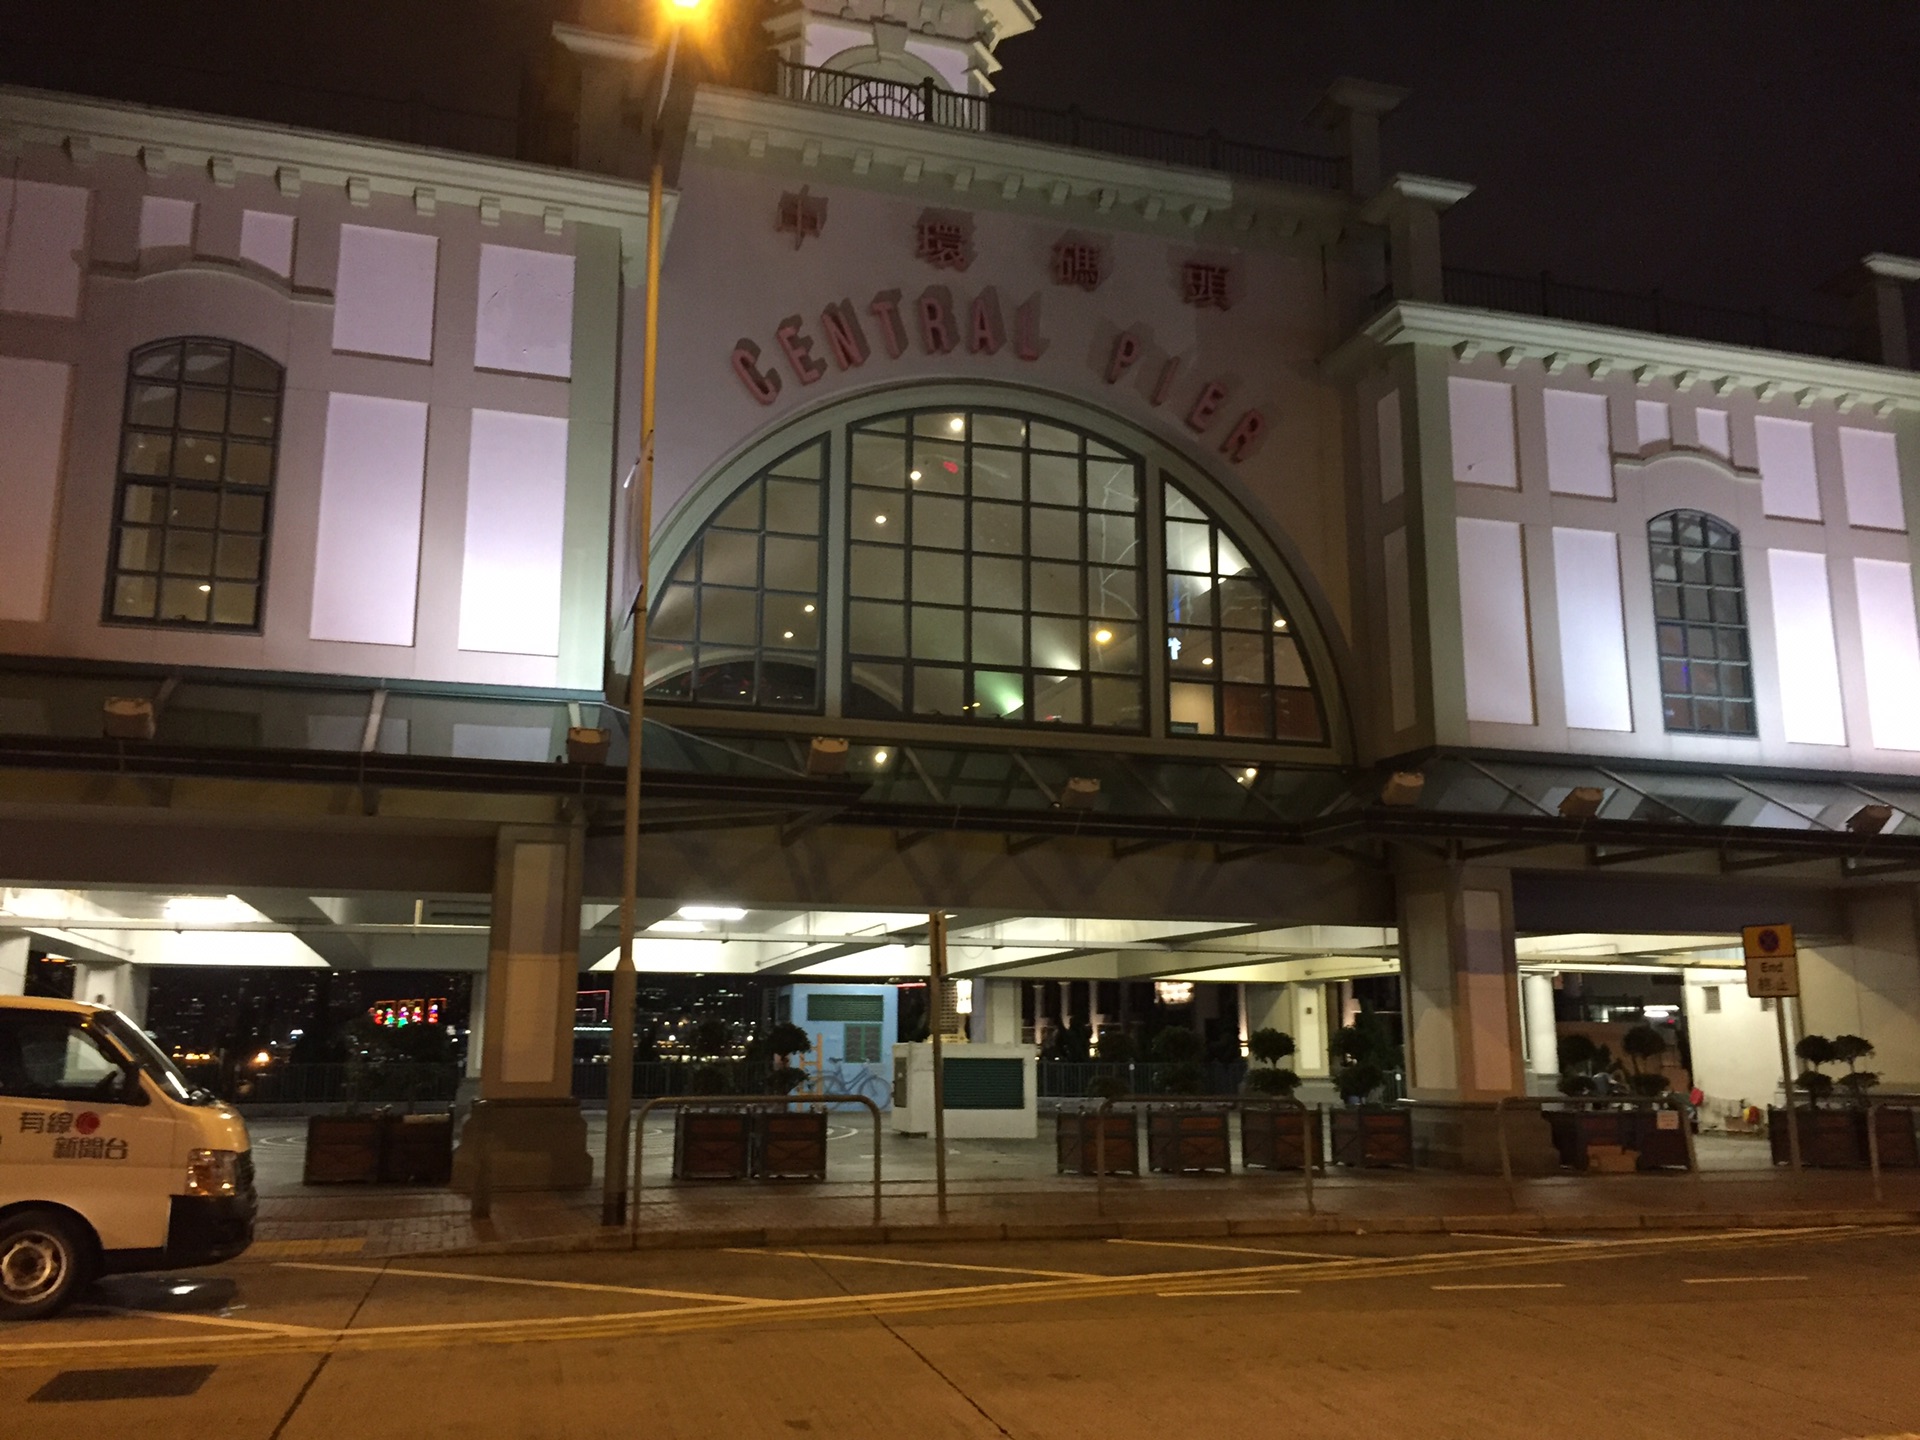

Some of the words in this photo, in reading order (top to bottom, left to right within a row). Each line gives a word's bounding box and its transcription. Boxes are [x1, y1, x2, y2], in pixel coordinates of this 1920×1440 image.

[775, 185, 1232, 311] 中環碼頭
[731, 296, 1040, 404] CENTRAL
[1105, 331, 1265, 463] PIER
[1761, 962, 1783, 973] End
[19, 1112, 74, 1134] 有線
[53, 1137, 128, 1160] 新聞台
